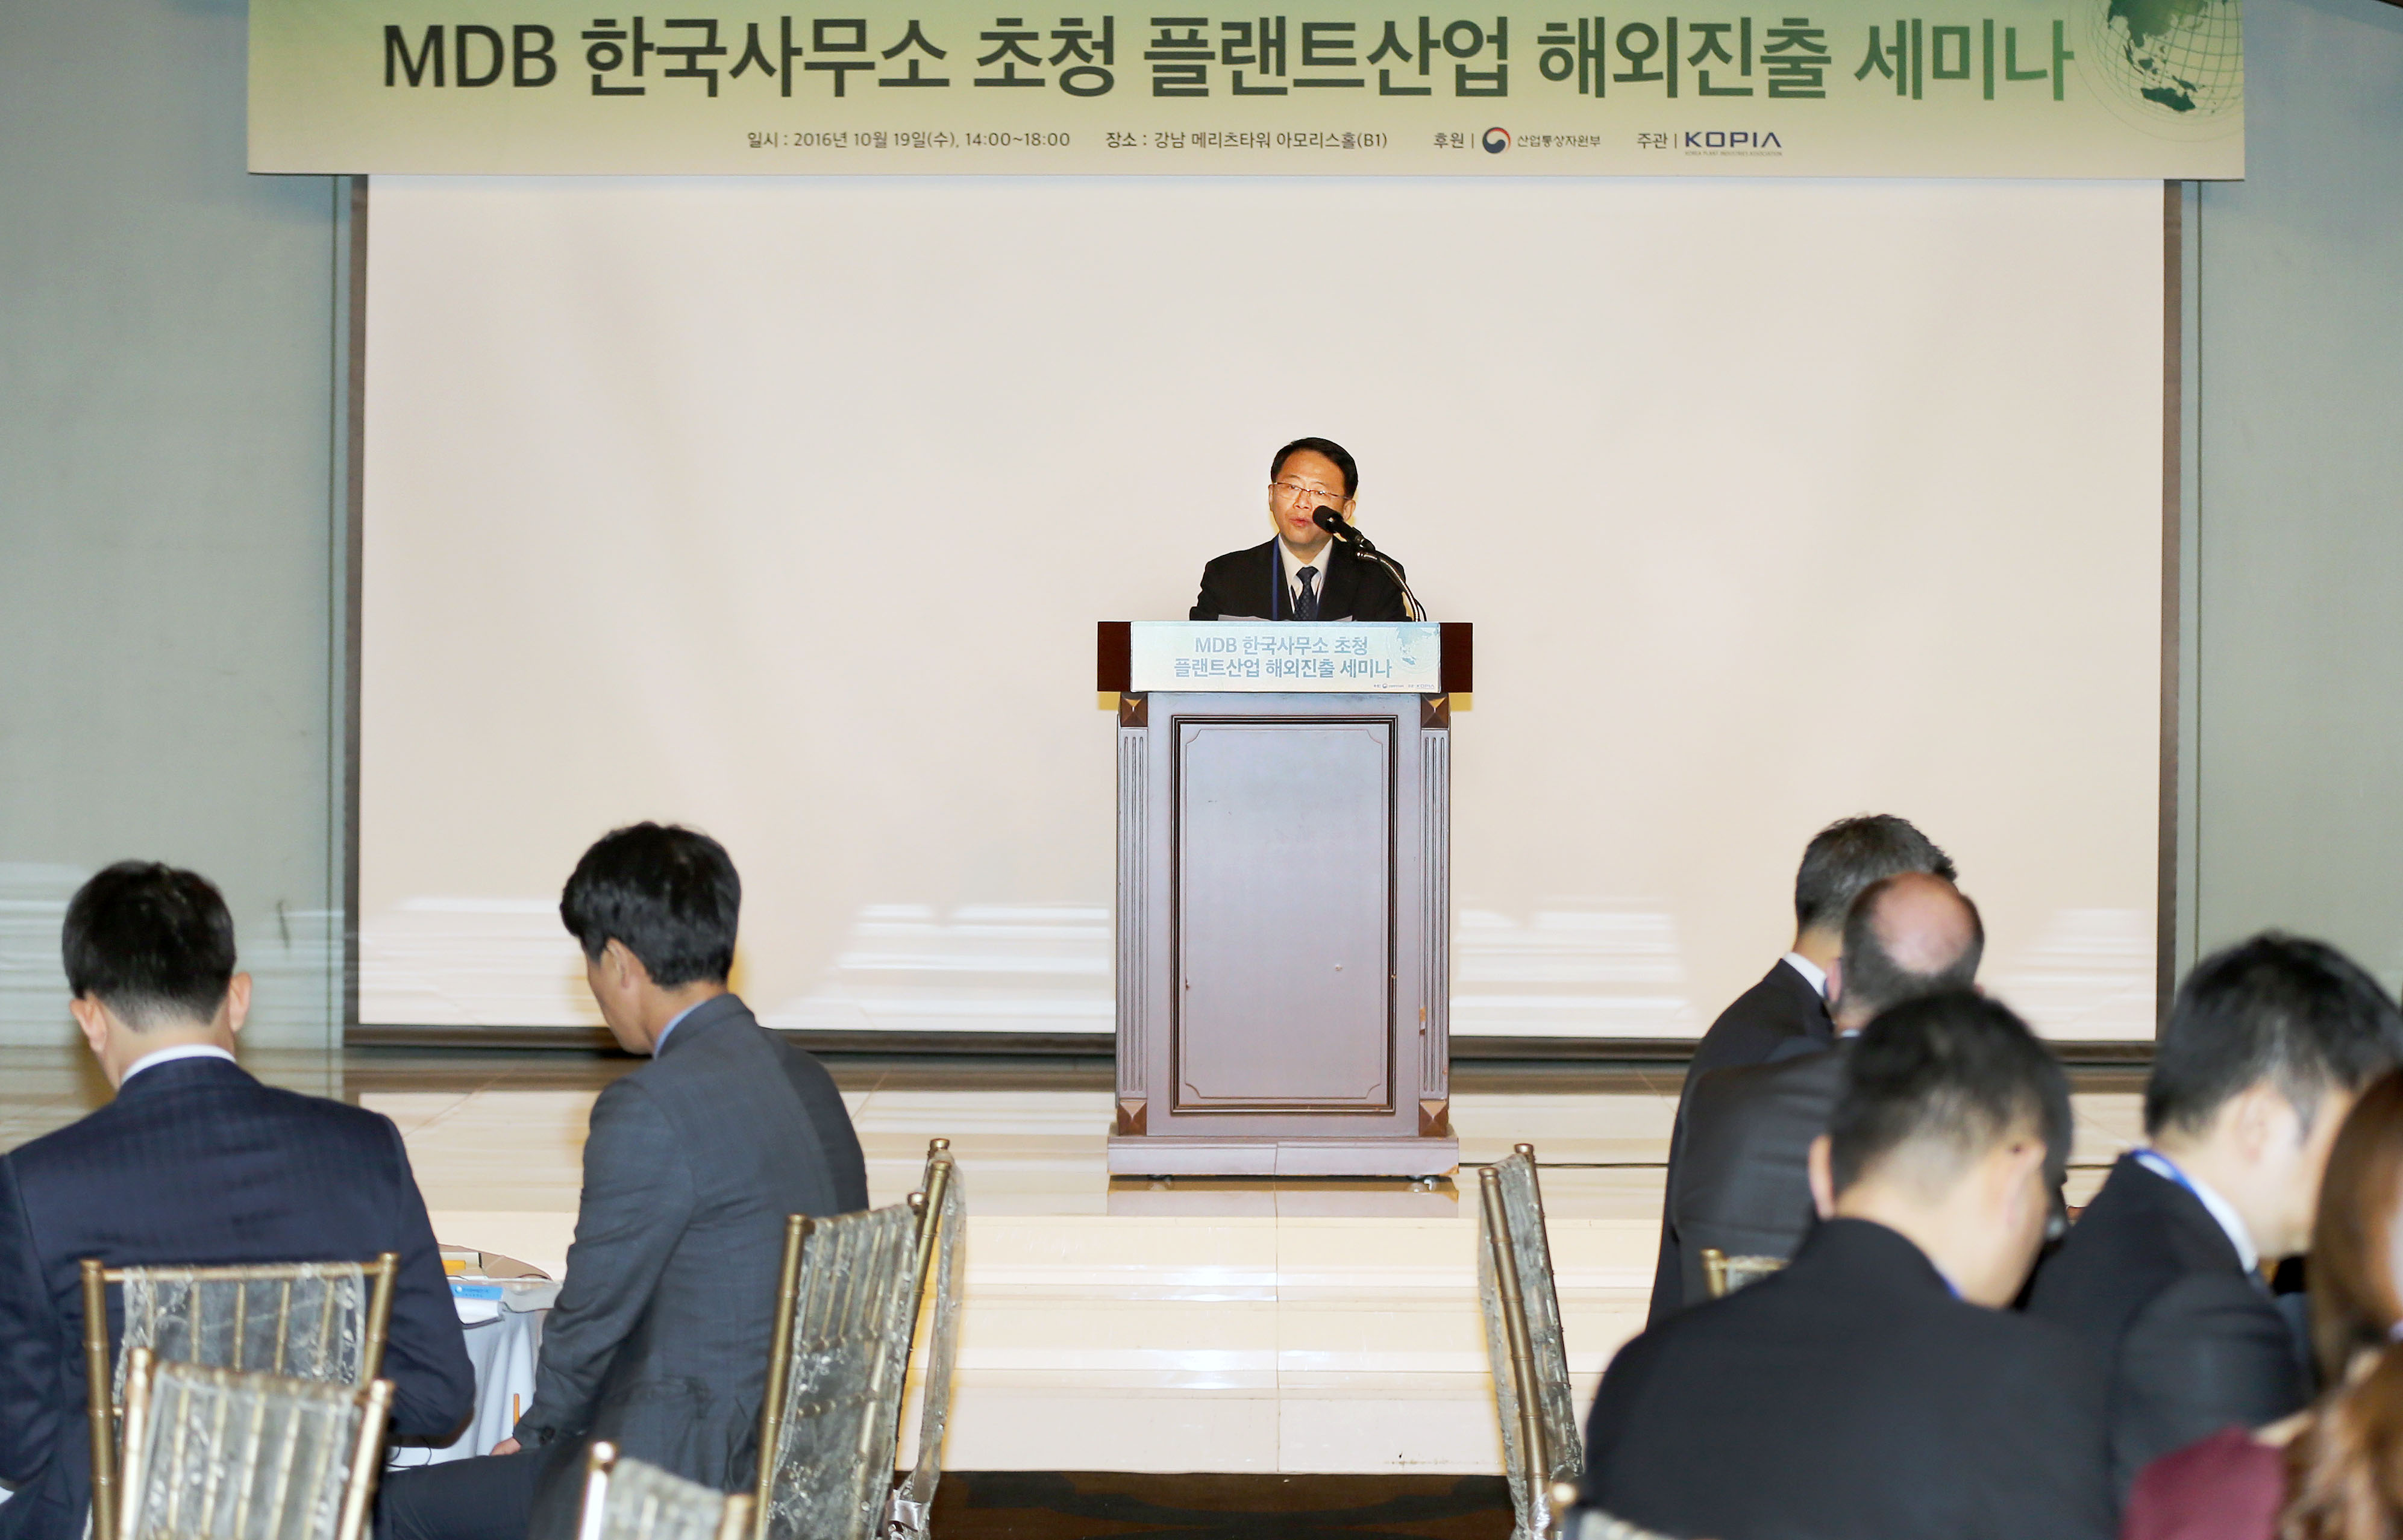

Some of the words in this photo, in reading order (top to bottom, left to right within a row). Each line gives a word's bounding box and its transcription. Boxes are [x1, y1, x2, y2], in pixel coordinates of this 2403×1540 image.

[383, 24, 558, 88] MDB
[580, 15, 950, 98] 한국사무소
[973, 15, 1115, 98] 초청
[1143, 15, 1508, 98] 플랜트산업
[1537, 16, 1832, 99] 해외진출
[1853, 18, 2075, 101] 세미나
[747, 131, 778, 148] 일시
[794, 131, 847, 148] 2016년
[854, 131, 888, 149] 10월
[965, 132, 1070, 146] 14:00~18:00
[1105, 131, 1138, 149] 장소
[1155, 131, 1186, 149] 강남
[1191, 131, 1270, 149] 메리츠타워
[1276, 131, 1388, 149] 아모리스홀(B1)
[1433, 132, 1464, 149] 후원
[1517, 134, 1601, 148] 산업통상자원부
[1637, 132, 1668, 149] 주관
[1685, 131, 1782, 148] KOPIA
[1195, 637, 1238, 653] MDB
[1242, 636, 1329, 654] 한국사무소
[1333, 636, 1368, 654] 초청
[1174, 657, 1260, 678] 플랜트산업
[1265, 658, 1335, 678] 해외진출
[1339, 659, 1393, 678] 세미나
